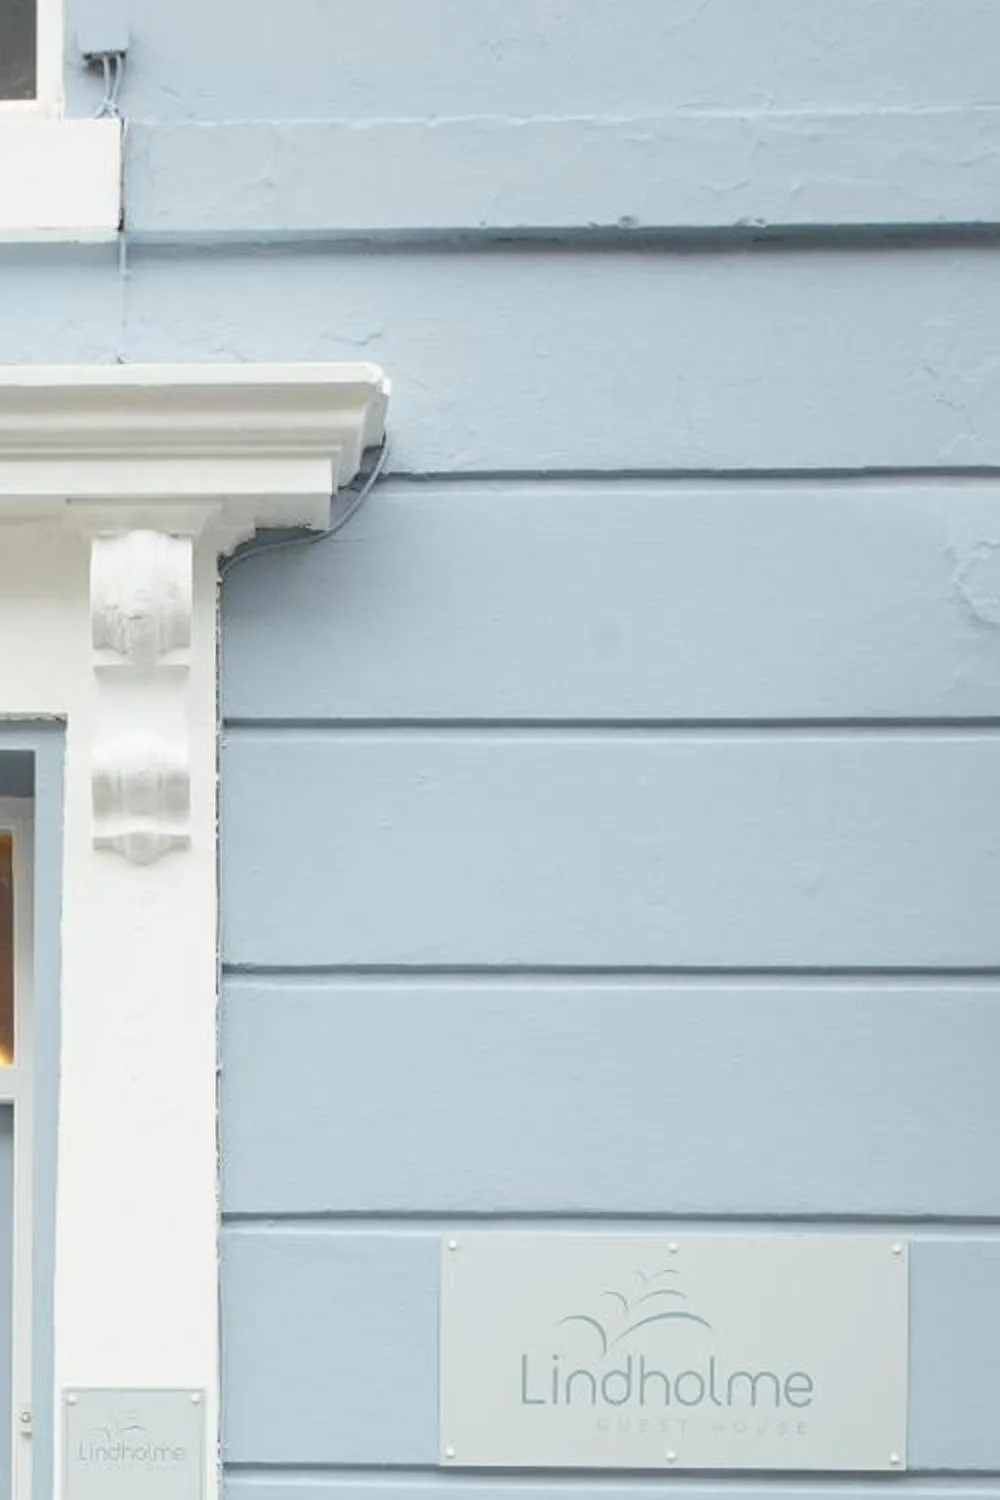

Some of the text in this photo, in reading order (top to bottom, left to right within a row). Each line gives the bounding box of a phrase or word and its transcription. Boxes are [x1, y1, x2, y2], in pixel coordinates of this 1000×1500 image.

[521, 1353, 814, 1409] Lindholme
[597, 1417, 810, 1437] GUEST HOUSE
[77, 1440, 187, 1462] Lindholme
